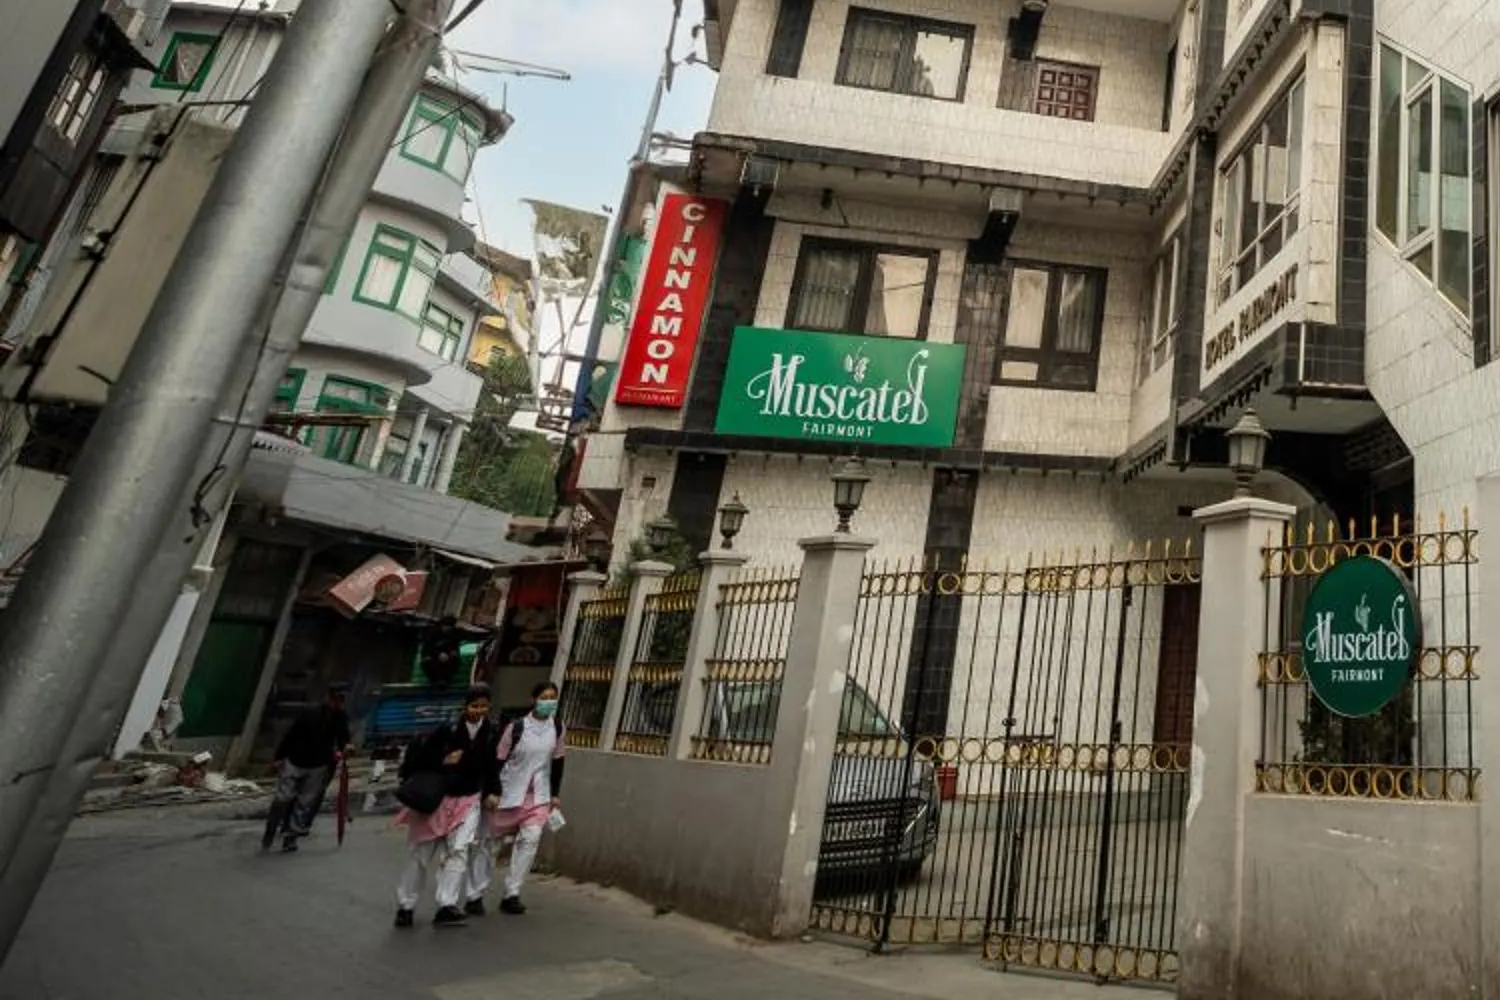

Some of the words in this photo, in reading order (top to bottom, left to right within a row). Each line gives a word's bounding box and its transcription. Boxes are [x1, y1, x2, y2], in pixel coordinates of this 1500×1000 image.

[639, 202, 705, 385] CINNAMON
[747, 349, 928, 425] Muscatel
[802, 422, 873, 439] FAIRMONT
[1305, 593, 1411, 663] Muscatel
[1331, 668, 1384, 683] FAIRMONT
